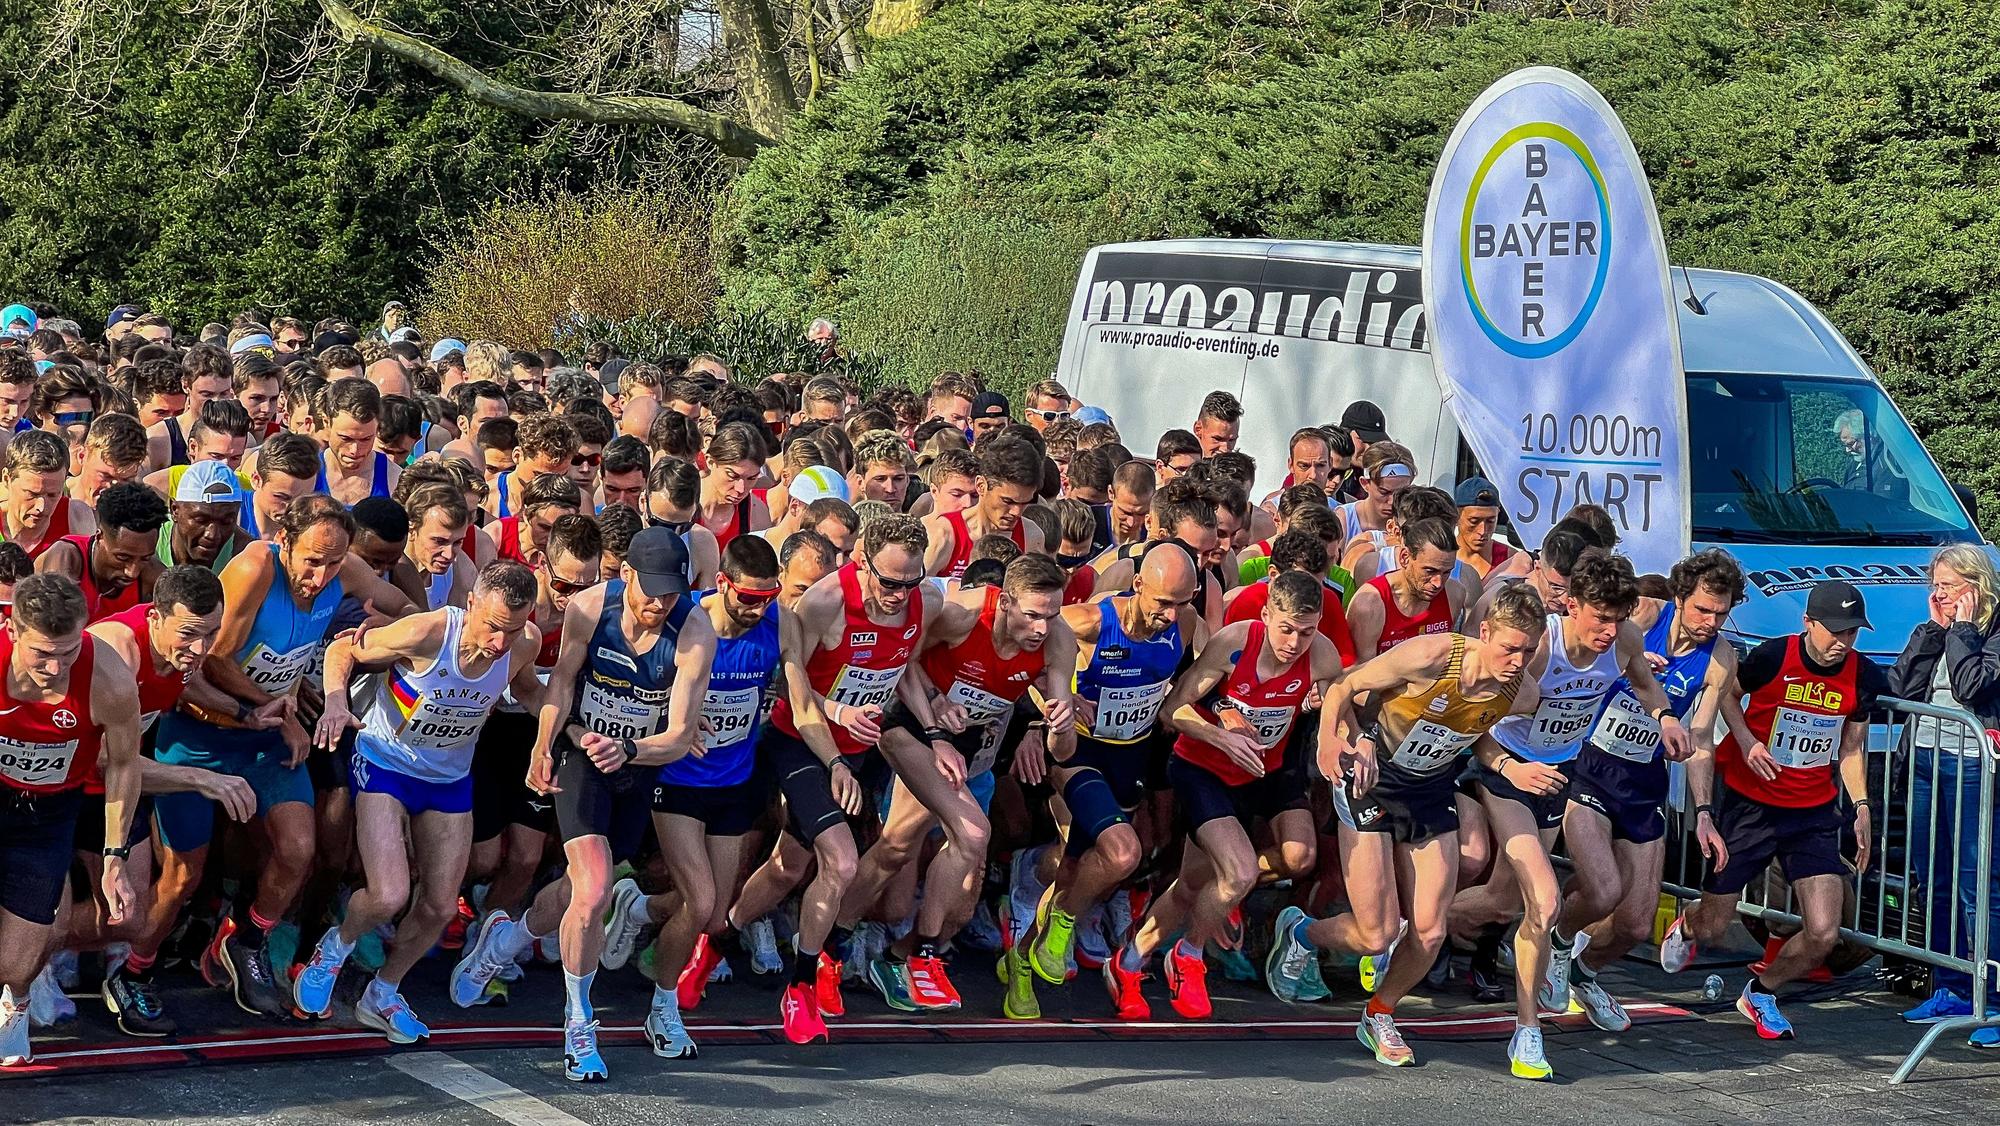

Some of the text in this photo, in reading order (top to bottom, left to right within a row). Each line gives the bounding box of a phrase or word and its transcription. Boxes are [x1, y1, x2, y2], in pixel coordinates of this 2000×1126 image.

[1474, 221, 1597, 258] BAYER
[1521, 144, 1549, 337] BAYER
[1100, 329, 1280, 360] www.proaudio-eventing.de
[1521, 413, 1662, 457] 10.000m
[1516, 467, 1663, 532] START
[1426, 621, 1449, 633] BIGGE
[852, 633, 876, 642] NTA
[710, 672, 726, 680] LIS
[1103, 699, 1161, 726] 10457
[1628, 715, 1650, 727] Lorenz
[410, 718, 478, 738] 10954
[584, 711, 648, 739] 10801
[1540, 714, 1593, 734] 10939
[1606, 717, 1660, 747] 10800
[1790, 725, 1826, 736] Süleyman
[1775, 732, 1833, 753] 11063
[0, 754, 66, 773] 0324
[1358, 806, 1379, 823] LSC
